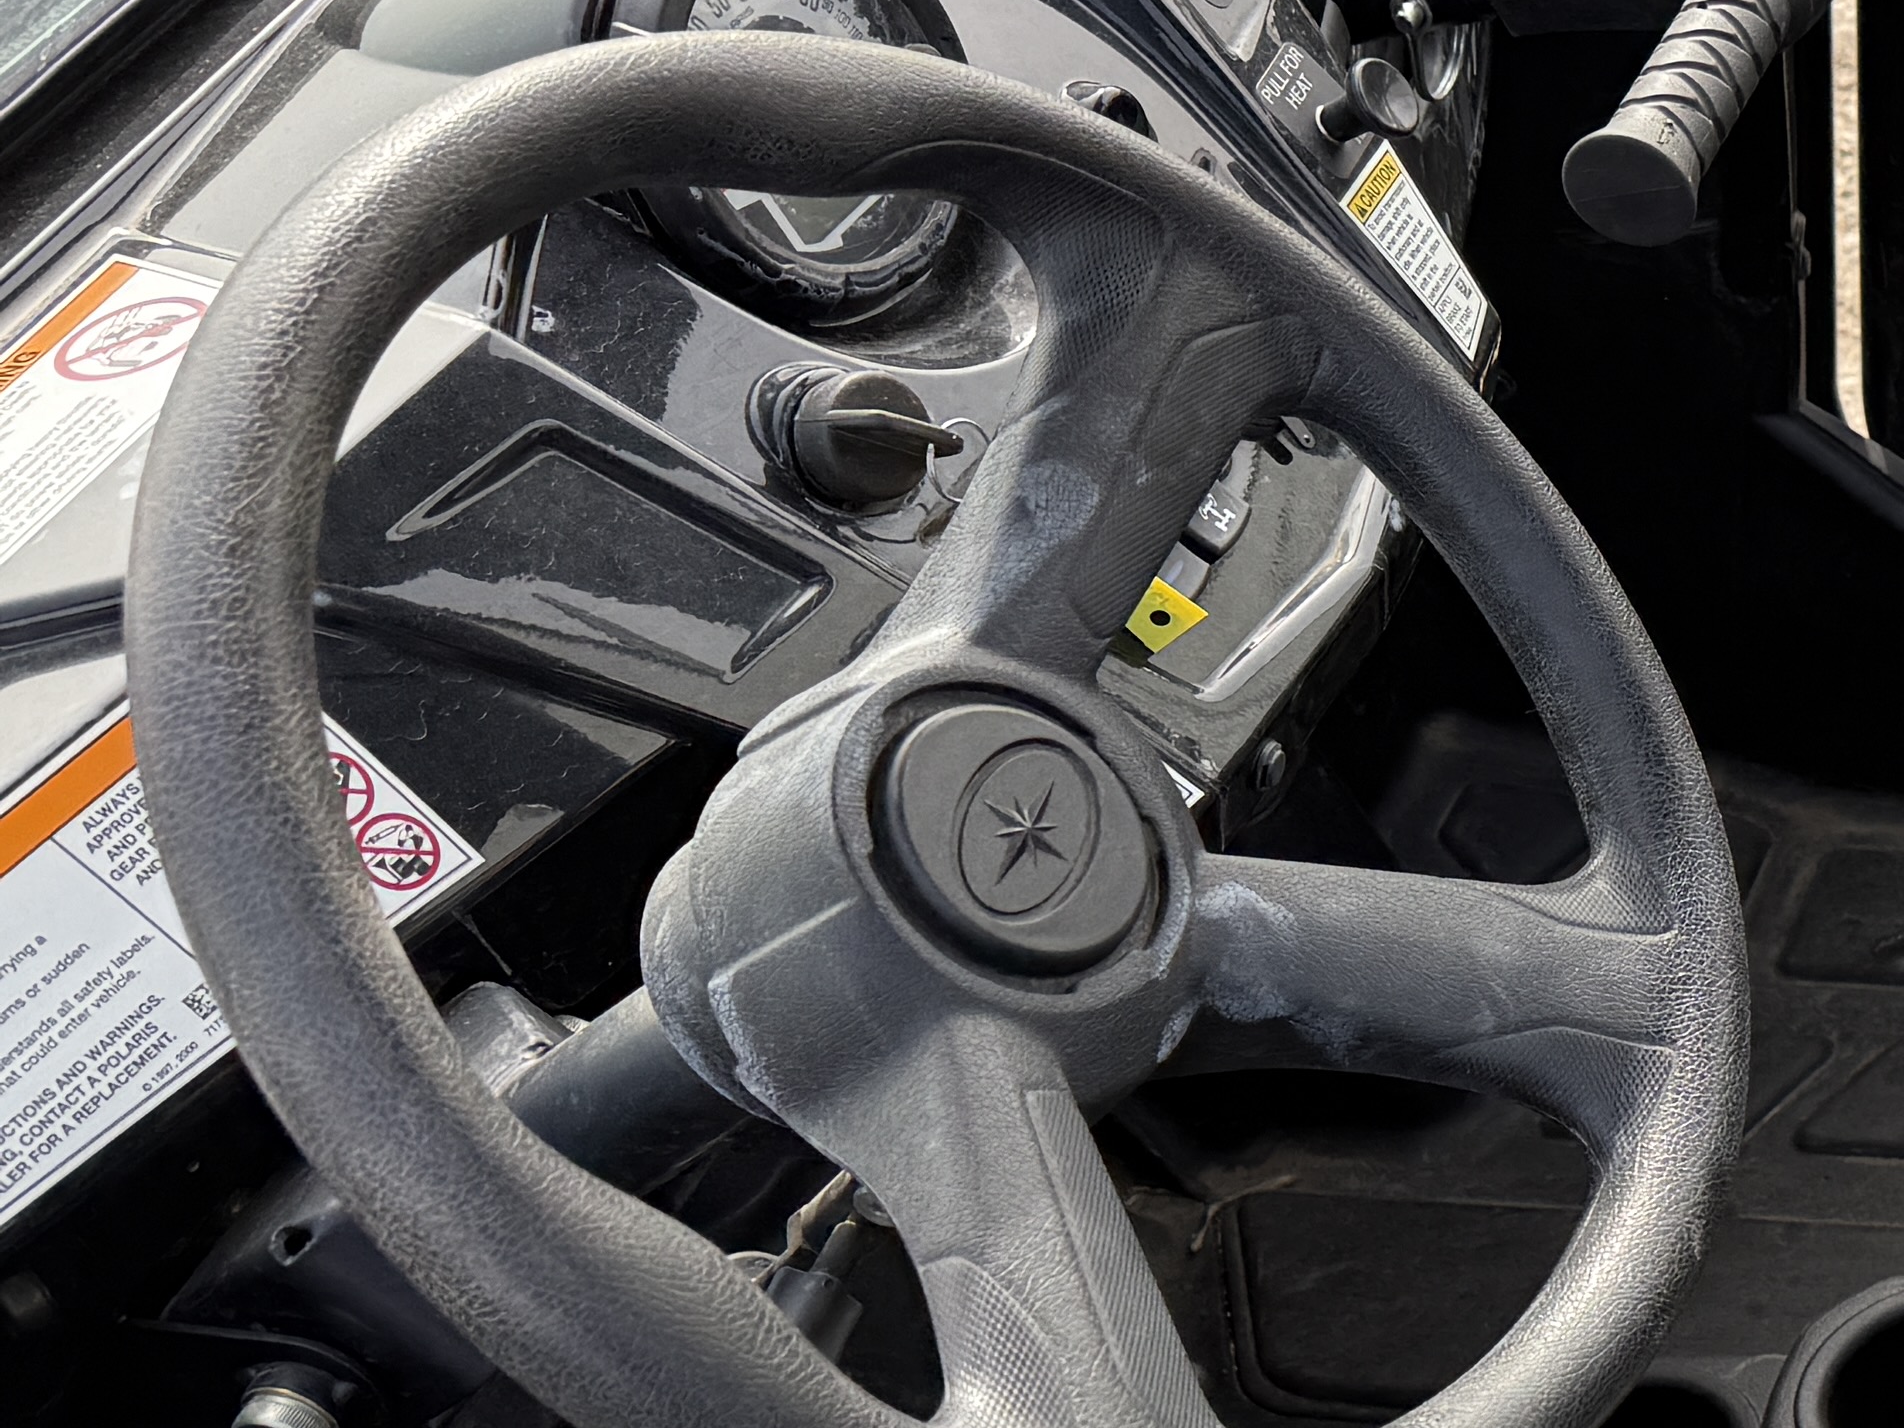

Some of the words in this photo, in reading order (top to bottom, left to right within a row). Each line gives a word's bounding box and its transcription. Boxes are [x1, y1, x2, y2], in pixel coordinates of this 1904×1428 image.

[1261, 69, 1289, 105] PULL
[1281, 47, 1305, 74] FOR
[1285, 73, 1314, 110] HEAT
[1359, 160, 1395, 207] CAUTION
[82, 783, 139, 832] ALWAYS
[106, 833, 136, 861] AND
[109, 847, 149, 880] GEAR
[25, 983, 40, 998] or
[41, 943, 89, 984] sudden
[56, 999, 74, 1017] all
[73, 966, 113, 1002] safety
[20, 1036, 58, 1072] could
[57, 1007, 91, 1038] enter
[55, 1060, 86, 1090] AND
[84, 995, 164, 1060] WARNINGS.
[19, 1085, 87, 1145] CONTACT
[86, 1075, 101, 1088] A
[98, 1022, 159, 1076] POLARIS
[28, 1133, 62, 1162] FOR
[61, 1123, 75, 1136] A
[72, 1032, 176, 1123] REPLACEMENT.
